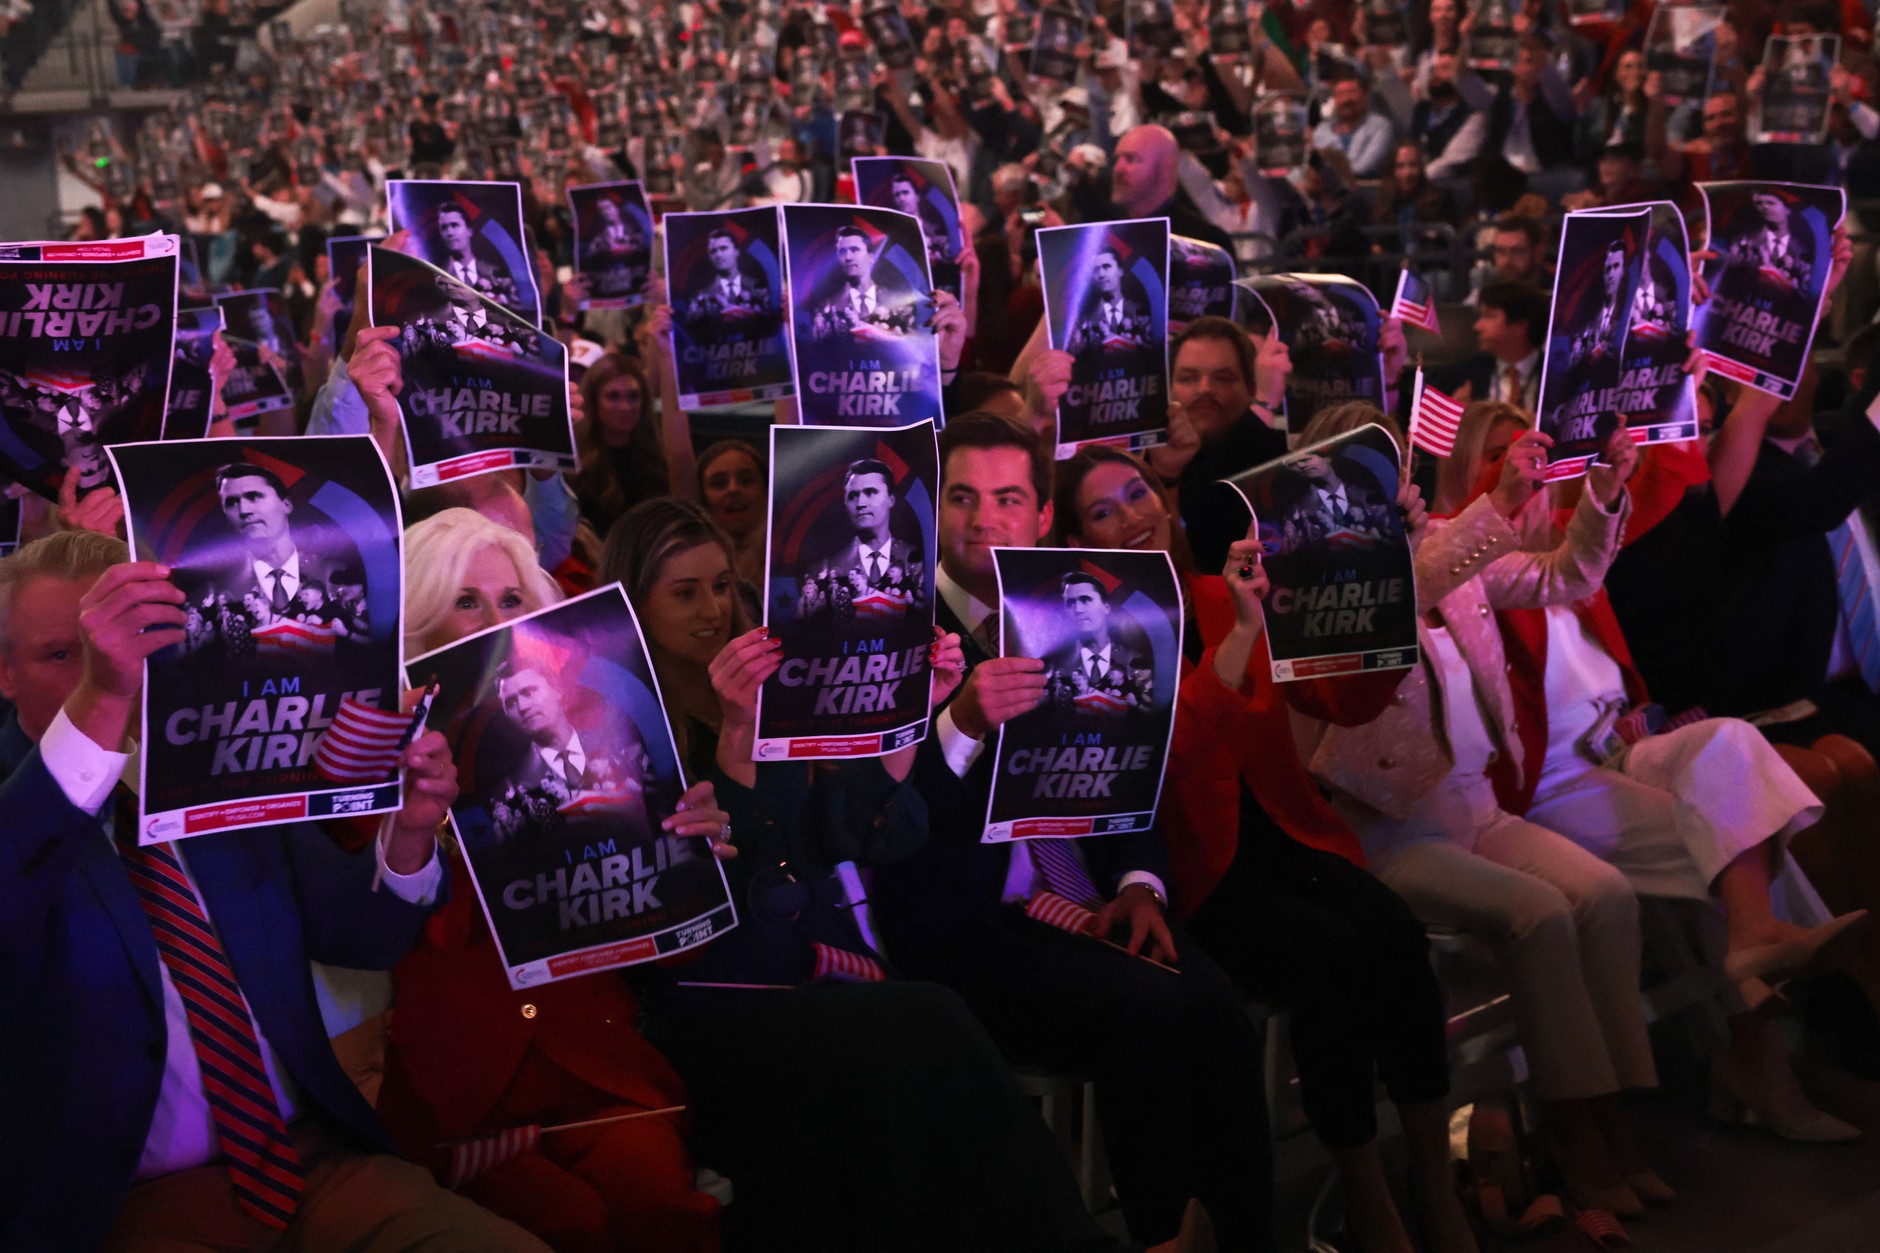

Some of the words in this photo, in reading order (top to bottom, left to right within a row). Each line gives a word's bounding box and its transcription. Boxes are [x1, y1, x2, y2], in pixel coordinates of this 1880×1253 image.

[21, 282, 125, 310] KIRK
[1709, 293, 1803, 344] CHARLIE
[53, 338, 86, 352] AM
[95, 338, 100, 350] I
[683, 338, 773, 365] CHARLIE
[1722, 322, 1779, 358] KIRK
[706, 358, 758, 379] KIRK
[860, 360, 881, 370] AM
[1108, 368, 1126, 380] AM
[1633, 355, 1653, 367] AM
[466, 376, 494, 390] AM
[1066, 374, 1159, 407] CHARLIE
[408, 387, 552, 418] CHARLIE
[838, 393, 902, 416] KIRK
[1089, 398, 1142, 425] KIRK
[440, 410, 523, 440] KIRK
[1333, 569, 1357, 583] AM
[1271, 578, 1404, 614] CHARLIE
[1302, 606, 1379, 639] KIRK
[843, 641, 848, 655] I
[856, 638, 884, 654] AM
[778, 643, 928, 687] CHARLIE
[243, 680, 249, 698] I
[260, 676, 300, 697] AM
[813, 680, 901, 715] KIRK
[1061, 733, 1067, 746] I
[1074, 733, 1103, 745] AM
[211, 731, 328, 776] KIRK
[1007, 745, 1155, 776] CHARLIE
[1031, 772, 1121, 799] KIRK
[332, 799, 375, 813] POINT
[564, 848, 572, 864] I
[583, 838, 617, 860] AM
[559, 874, 663, 931] KIRK
[679, 924, 713, 947] POINT
